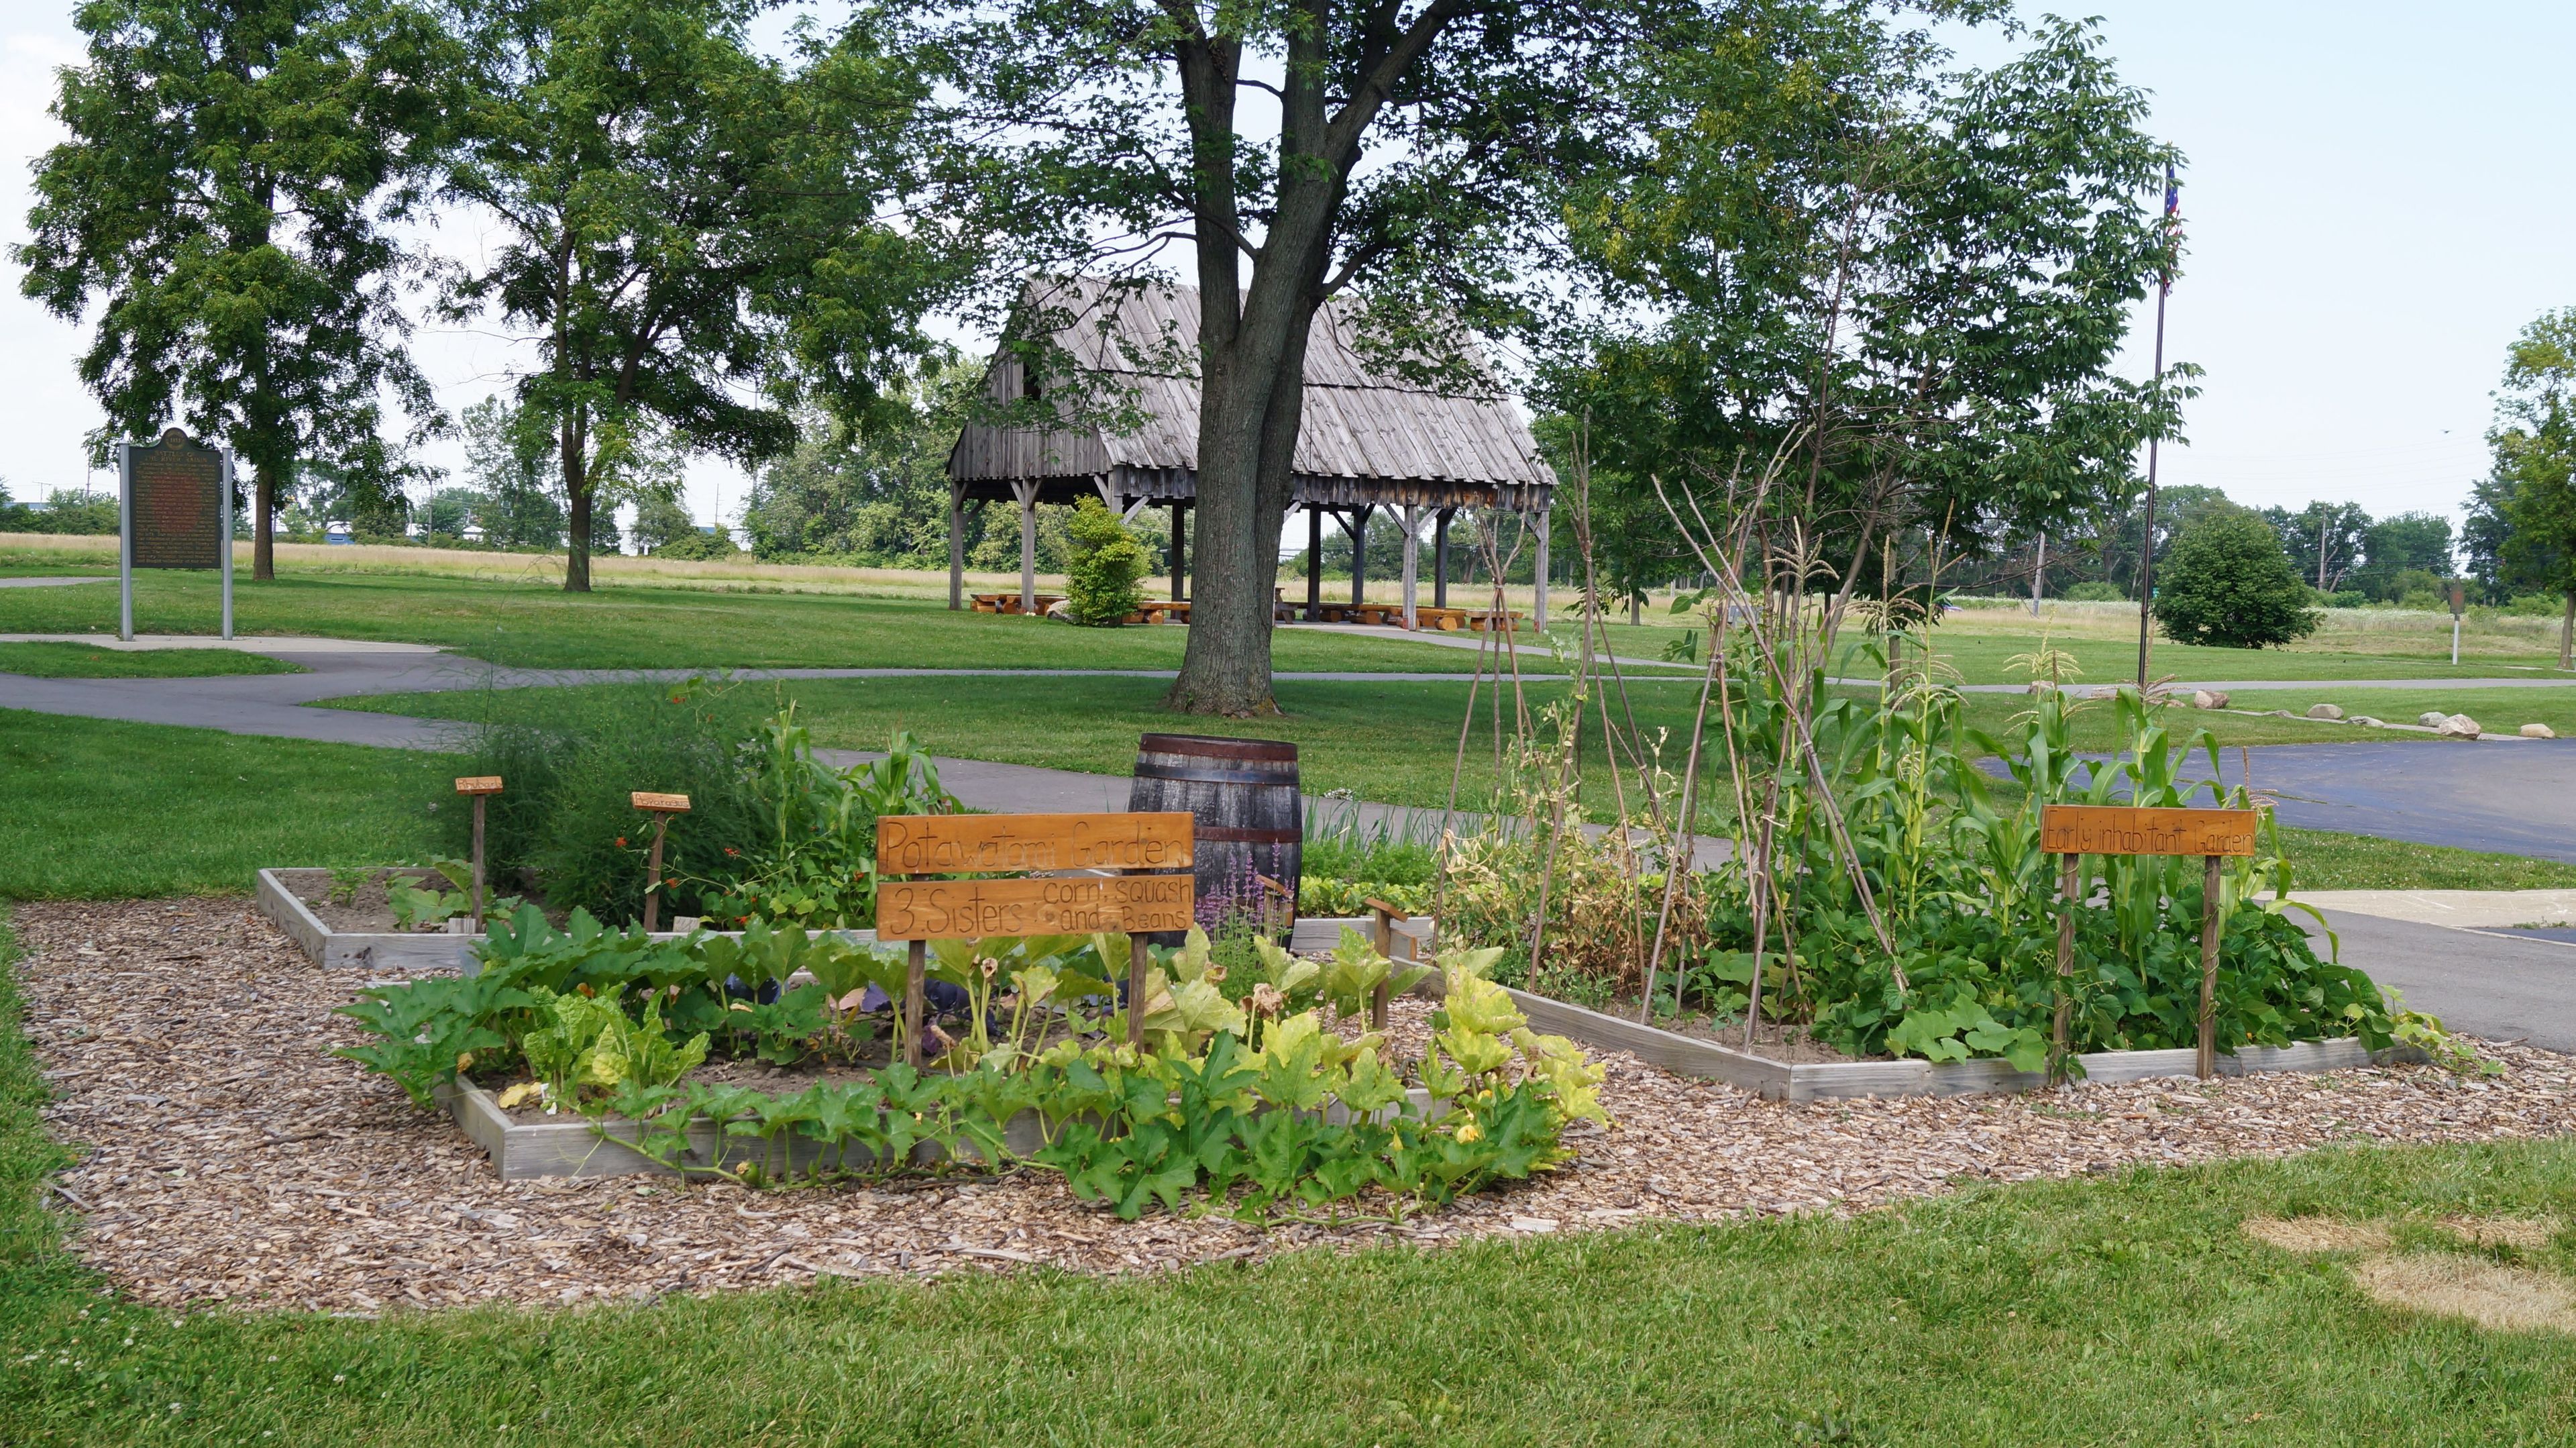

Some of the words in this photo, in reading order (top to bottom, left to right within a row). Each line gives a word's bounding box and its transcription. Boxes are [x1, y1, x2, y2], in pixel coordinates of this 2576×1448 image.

[458, 777, 502, 790] Rhubarb
[634, 792, 689, 808] Asparagus
[885, 821, 1056, 868] Potawatomi
[1071, 820, 1185, 867] Garden
[2045, 809, 2092, 850] Early
[2098, 814, 2187, 852] inhabitant
[2194, 819, 2254, 854] Garden
[1061, 903, 1100, 931] and
[1121, 906, 1187, 931] Beans
